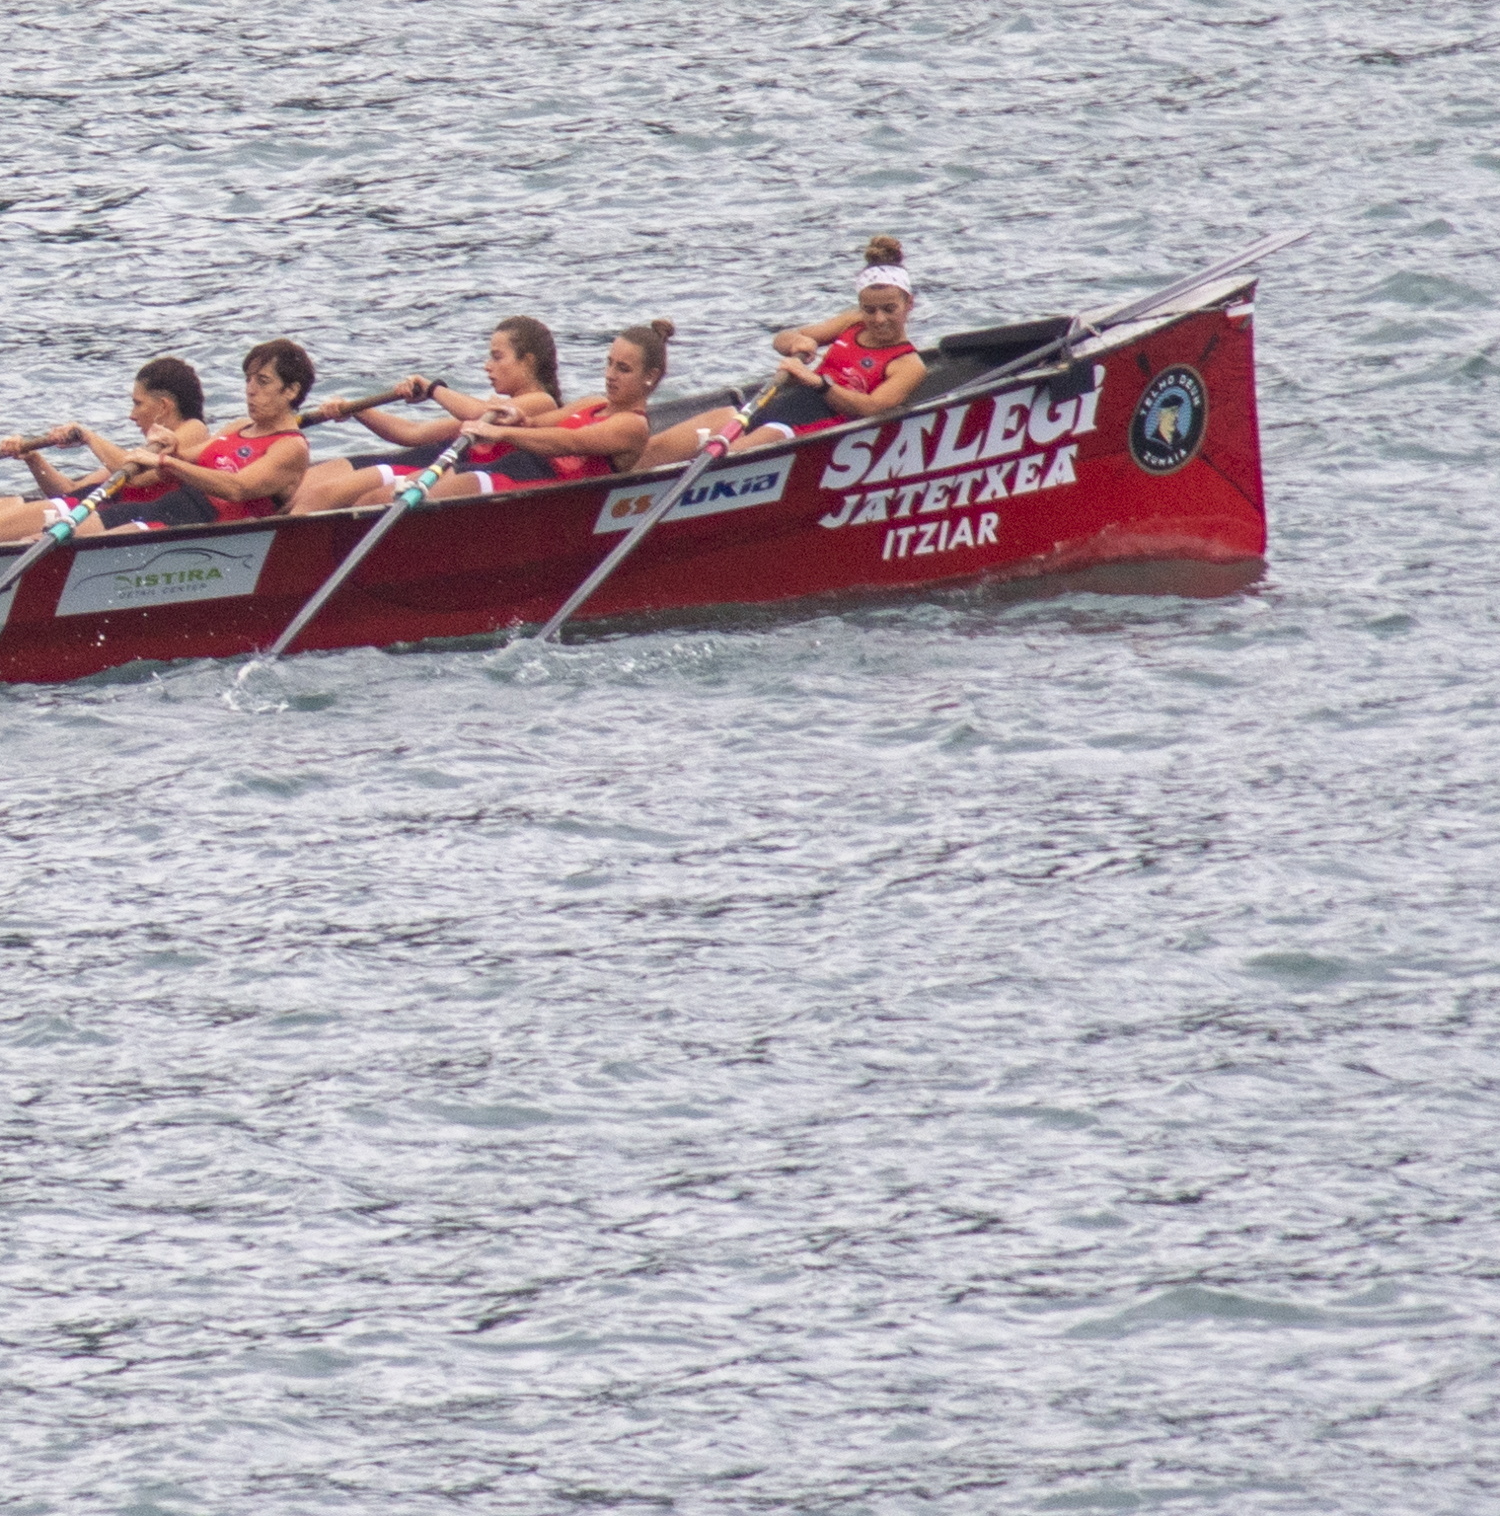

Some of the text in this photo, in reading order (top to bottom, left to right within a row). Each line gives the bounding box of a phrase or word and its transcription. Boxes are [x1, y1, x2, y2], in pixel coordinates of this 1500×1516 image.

[1140, 374, 1201, 415] TELMO DEUN
[1143, 448, 1187, 466] ZUMAIA
[818, 443, 1079, 528] JATETXEA
[882, 511, 1000, 560] ITZIAR
